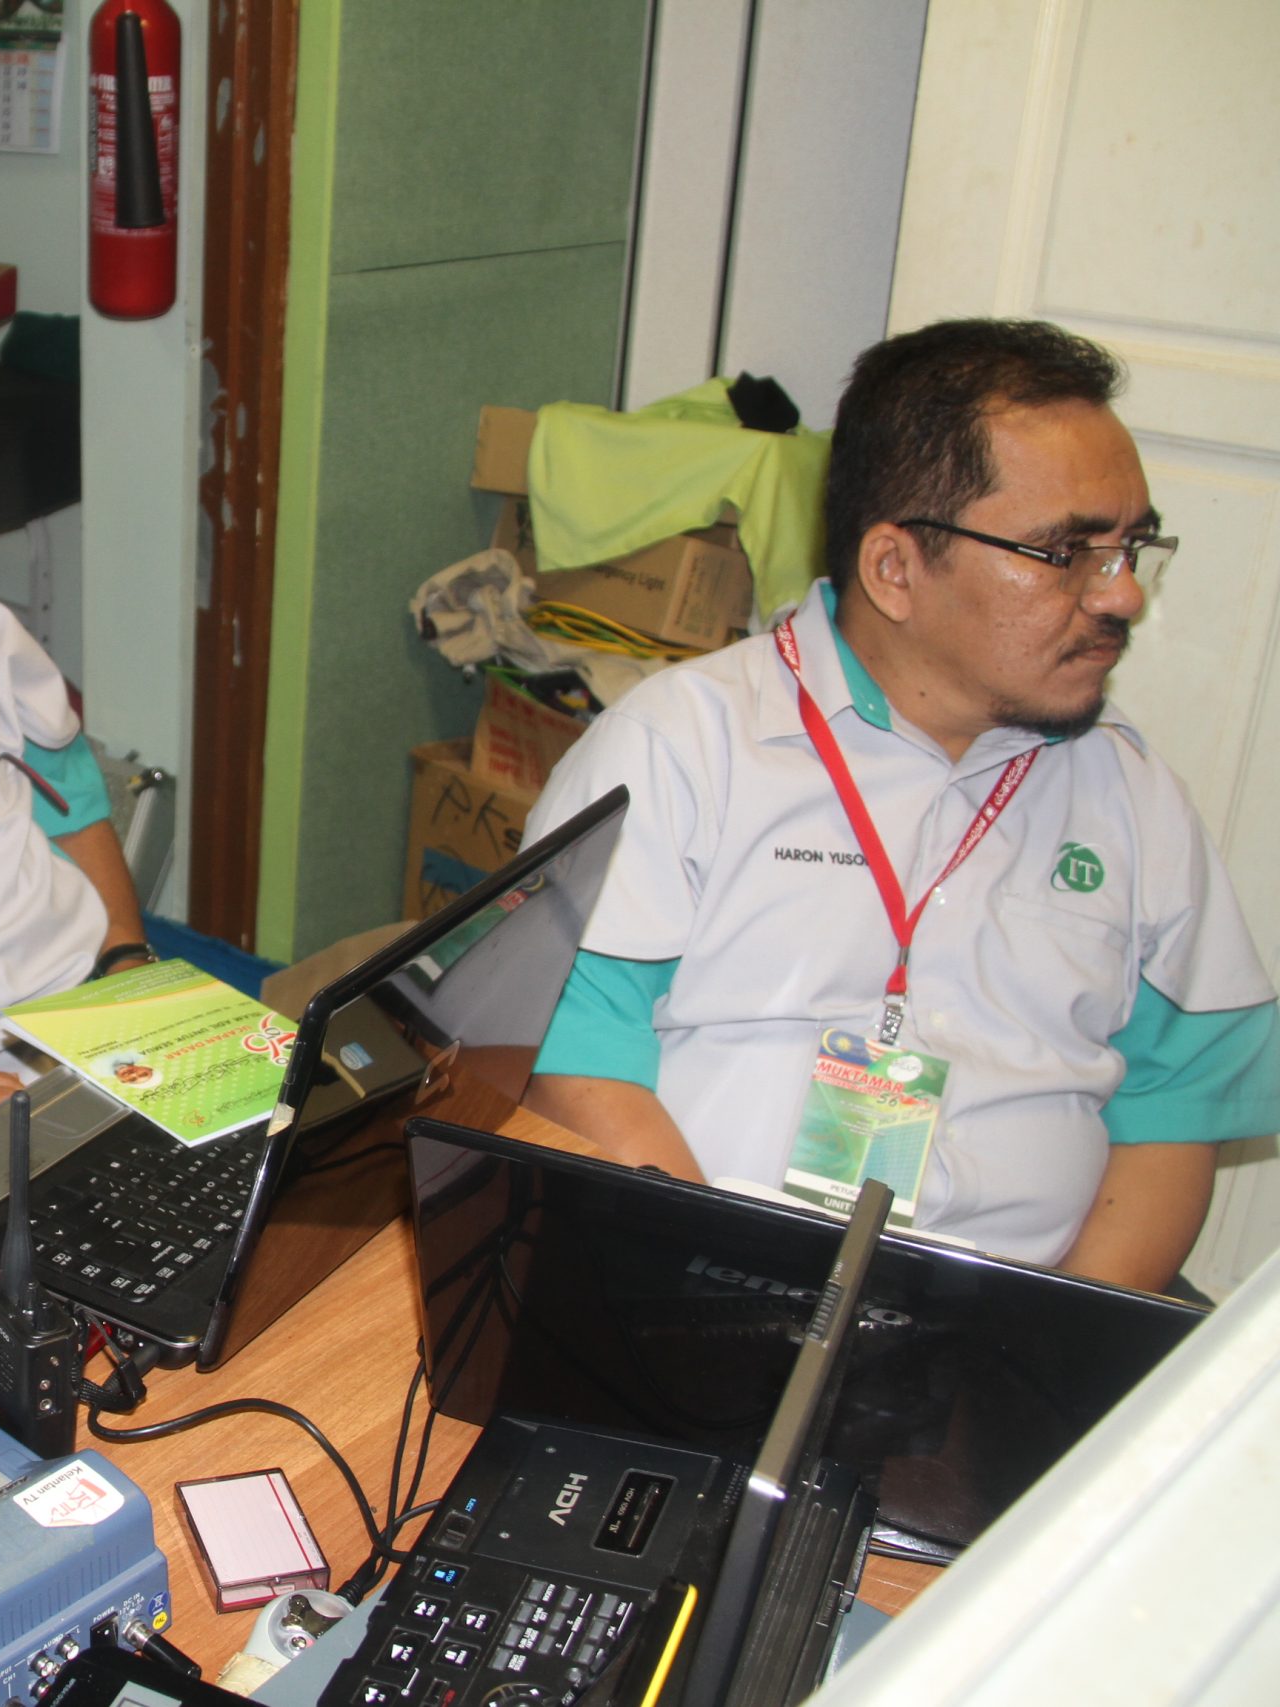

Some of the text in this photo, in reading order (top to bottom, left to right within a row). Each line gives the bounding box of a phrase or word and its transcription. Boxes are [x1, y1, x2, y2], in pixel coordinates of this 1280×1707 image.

[638, 573, 666, 592] Light
[775, 847, 869, 867] HARON YUSO
[1067, 857, 1100, 886] IT
[164, 1025, 253, 1061] UCAPAN DASAR
[176, 1027, 210, 1043] UNTUK
[141, 1040, 174, 1056] SEMUA
[815, 1059, 906, 1094] MUKTAMAR
[824, 1196, 851, 1211] UNIT
[686, 1255, 913, 1326] lenoo
[23, 1465, 84, 1506] Kelantan TV
[548, 1472, 589, 1527] HDV
[92, 1606, 116, 1623] POWER
[3, 1674, 17, 1685] CH1
